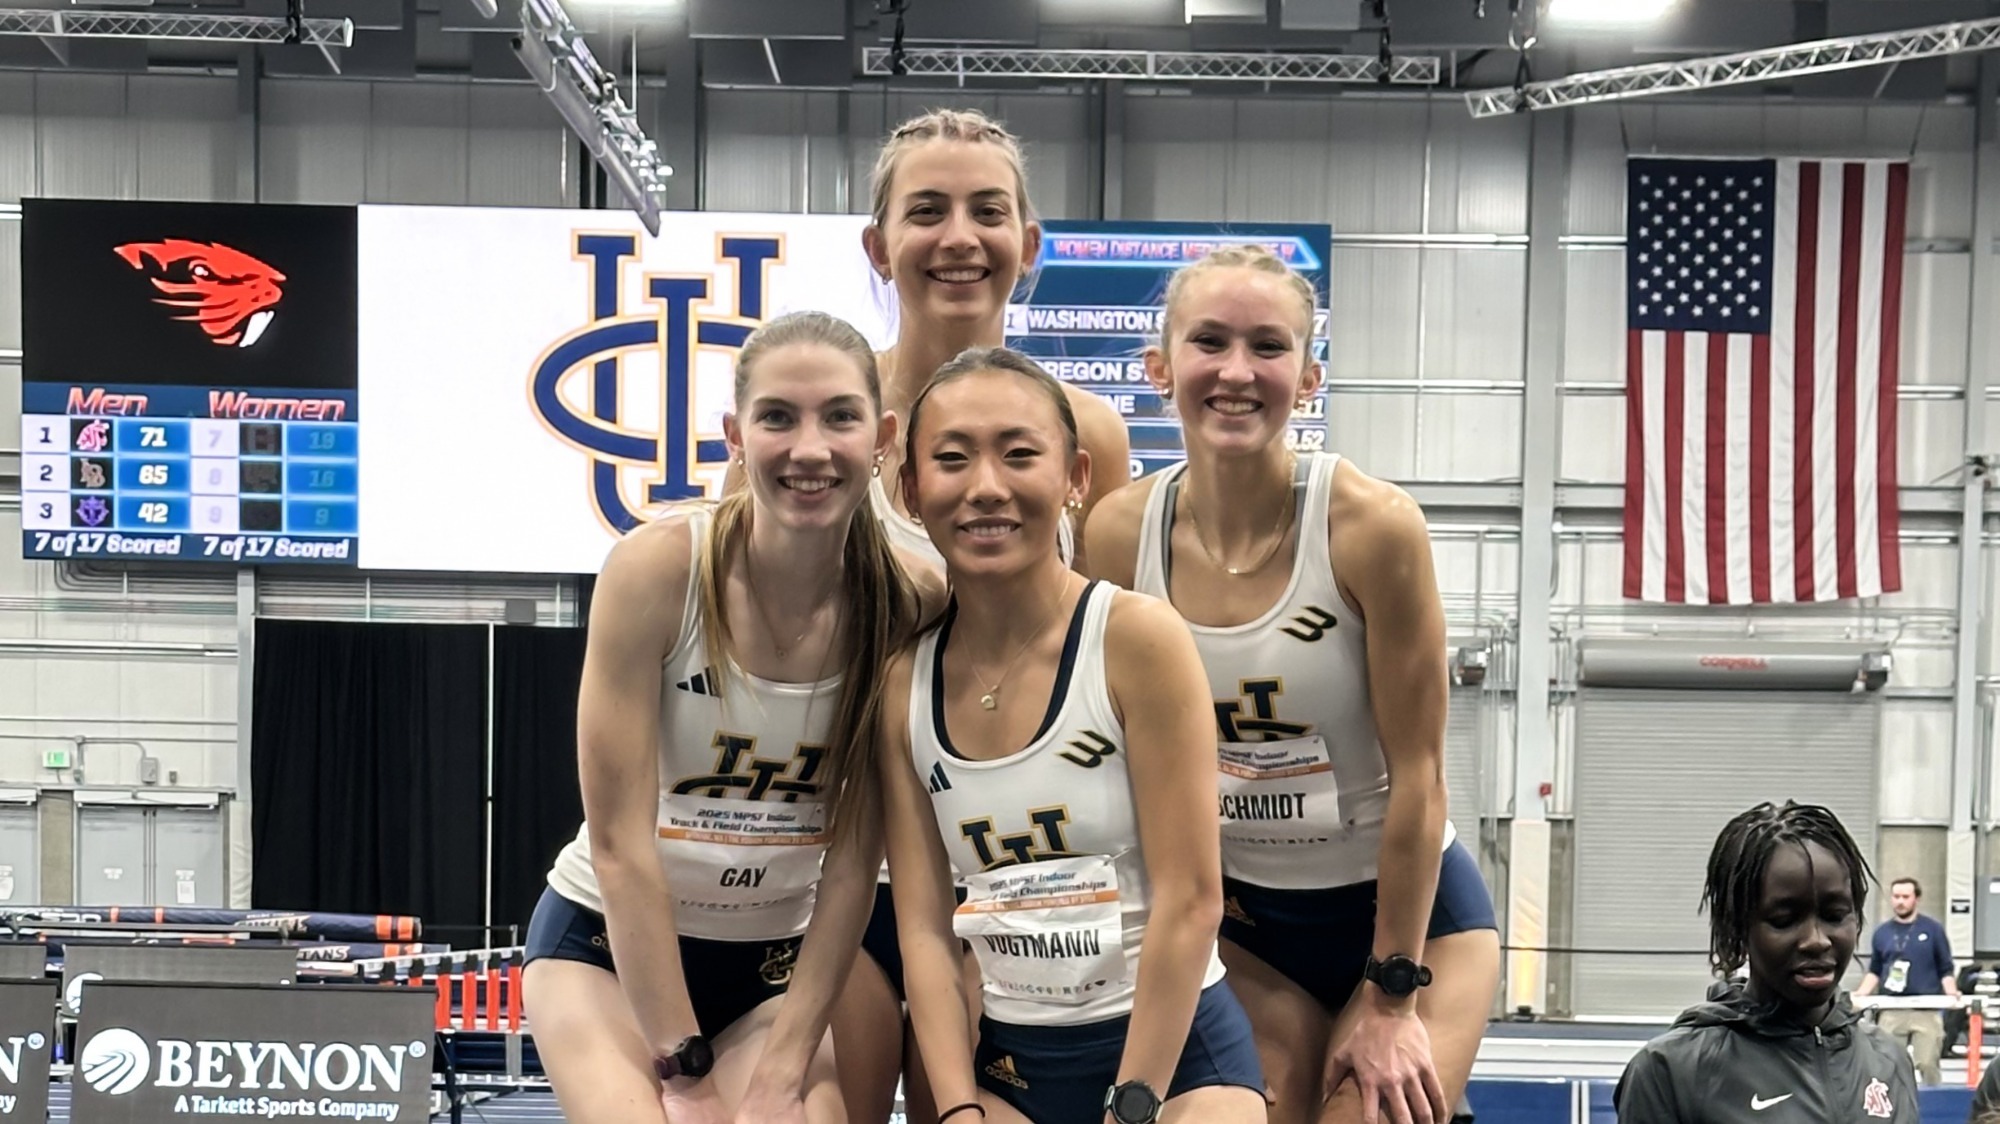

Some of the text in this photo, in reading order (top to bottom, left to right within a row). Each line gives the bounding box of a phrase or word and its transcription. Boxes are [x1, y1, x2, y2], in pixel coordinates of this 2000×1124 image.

[1110, 240, 1180, 259] DISTANCE
[1028, 309, 1153, 330] WASHINGTON
[67, 387, 148, 416] Men
[208, 391, 346, 421] Women
[40, 426, 167, 448] 1 71
[208, 430, 222, 448] 7
[40, 465, 53, 482] 2
[40, 503, 168, 523] 3 42
[35, 533, 181, 557] 7 of 17 Scored
[203, 536, 350, 561] 7 of 17 Scored
[670, 817, 699, 829] Track
[697, 808, 731, 820] 2025
[720, 866, 767, 888] GAY
[1038, 871, 1077, 883] Indoor
[154, 1039, 407, 1092] BEYNON
[174, 1095, 399, 1122] A Tarkett Sports Company
